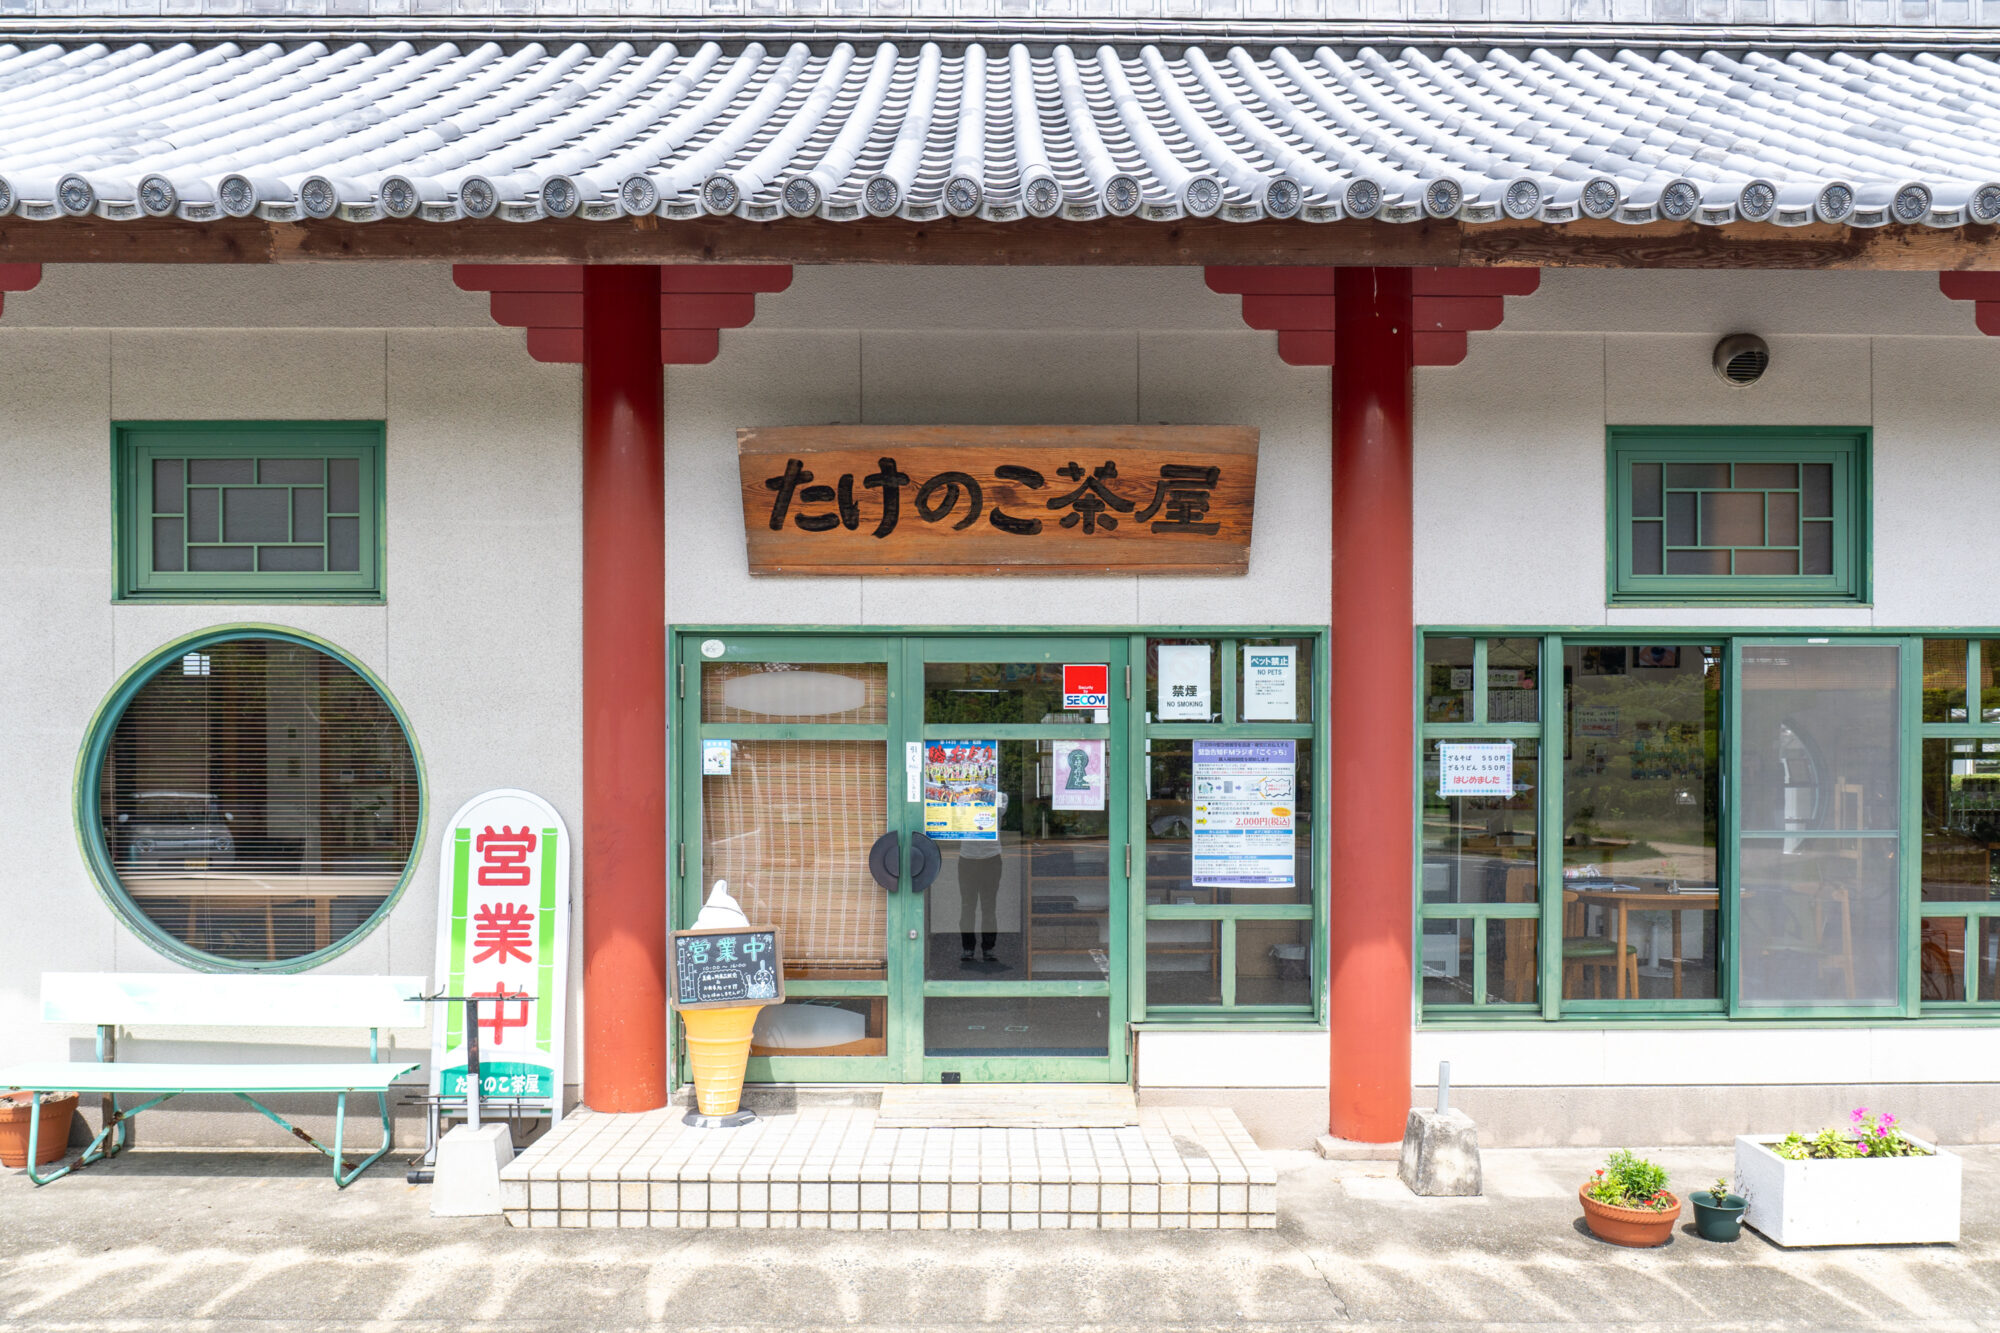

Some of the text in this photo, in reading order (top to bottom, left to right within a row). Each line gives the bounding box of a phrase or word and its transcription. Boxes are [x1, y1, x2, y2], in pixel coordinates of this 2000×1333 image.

[765, 456, 1222, 539] たけのこ茶屋
[1251, 657, 1288, 666] ペット禁止
[1172, 685, 1197, 697] 禁煙
[1066, 695, 1105, 705] SECOM
[1453, 776, 1500, 784] はじめました
[1235, 817, 1290, 826] 2,000円(税込)
[472, 825, 537, 1045] 営業中
[688, 936, 765, 964] 営業中
[455, 1074, 540, 1093] たのこ茶屋
